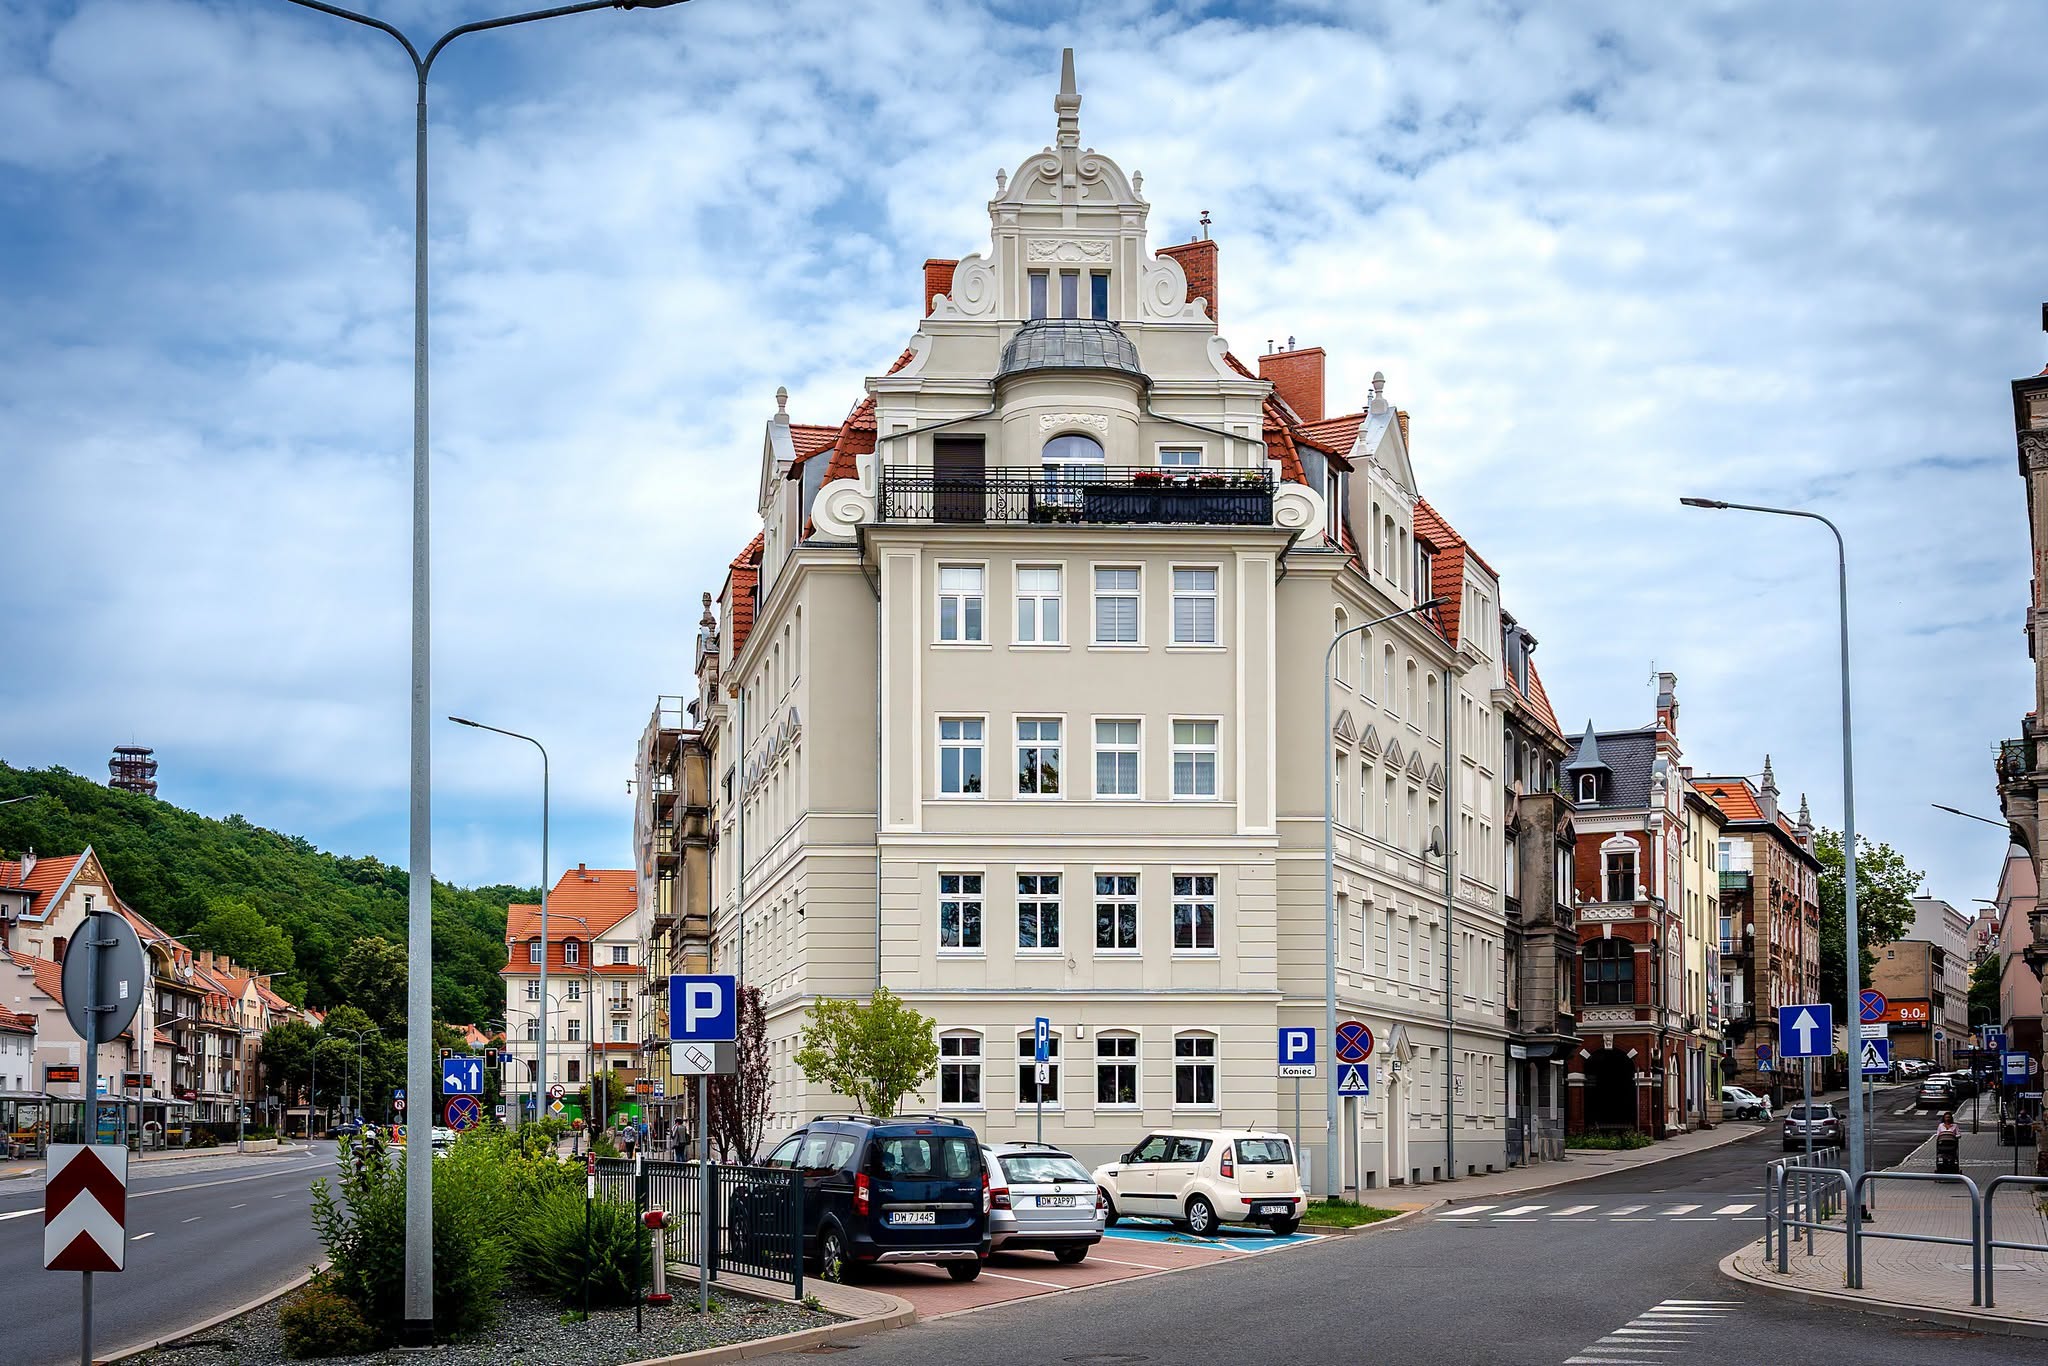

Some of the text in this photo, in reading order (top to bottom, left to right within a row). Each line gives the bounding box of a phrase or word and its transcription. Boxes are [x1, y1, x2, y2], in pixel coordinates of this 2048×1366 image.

[685, 982, 722, 1032] P
[1039, 1021, 1047, 1049] P
[1287, 1031, 1308, 1060] P
[1283, 1067, 1312, 1075] Koniec
[1041, 1196, 1074, 1206] DW 2AP97
[894, 1212, 934, 1222] DW 7J445
